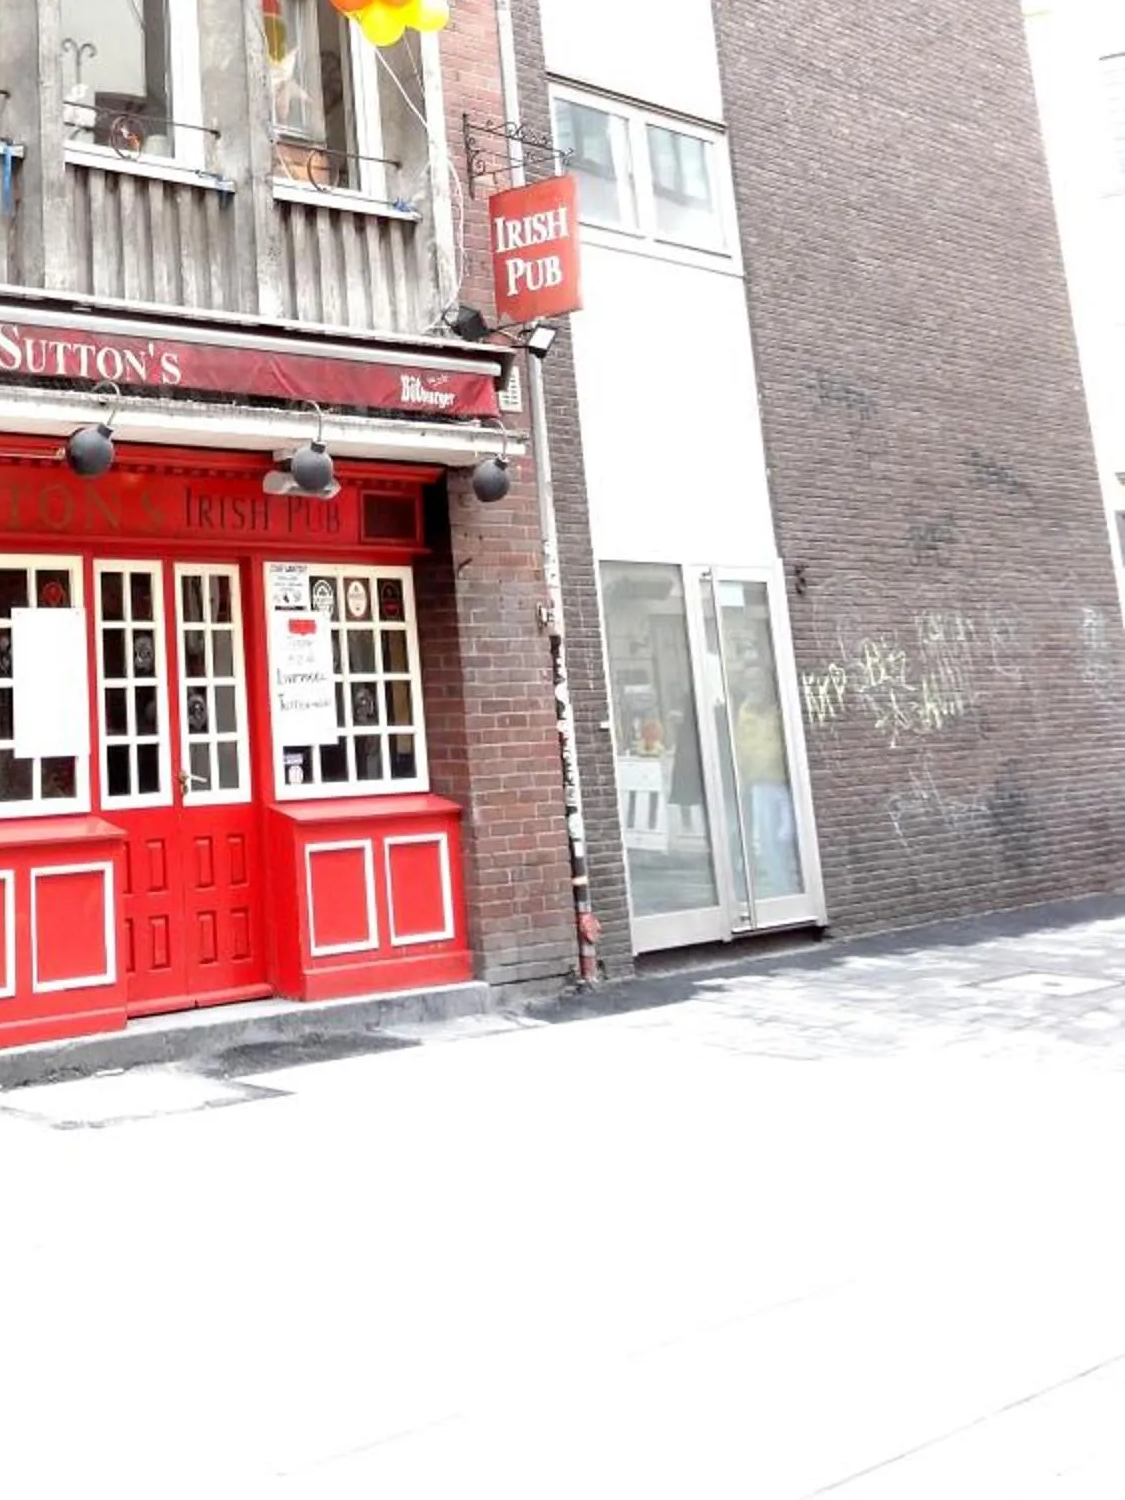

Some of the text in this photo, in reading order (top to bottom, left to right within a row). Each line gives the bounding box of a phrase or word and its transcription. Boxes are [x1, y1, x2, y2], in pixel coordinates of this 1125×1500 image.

[495, 204, 570, 253] IRISH
[506, 255, 563, 297] PUB
[400, 373, 457, 409] Bitburger
[184, 485, 271, 533] IRISH
[287, 494, 342, 534] PUB
